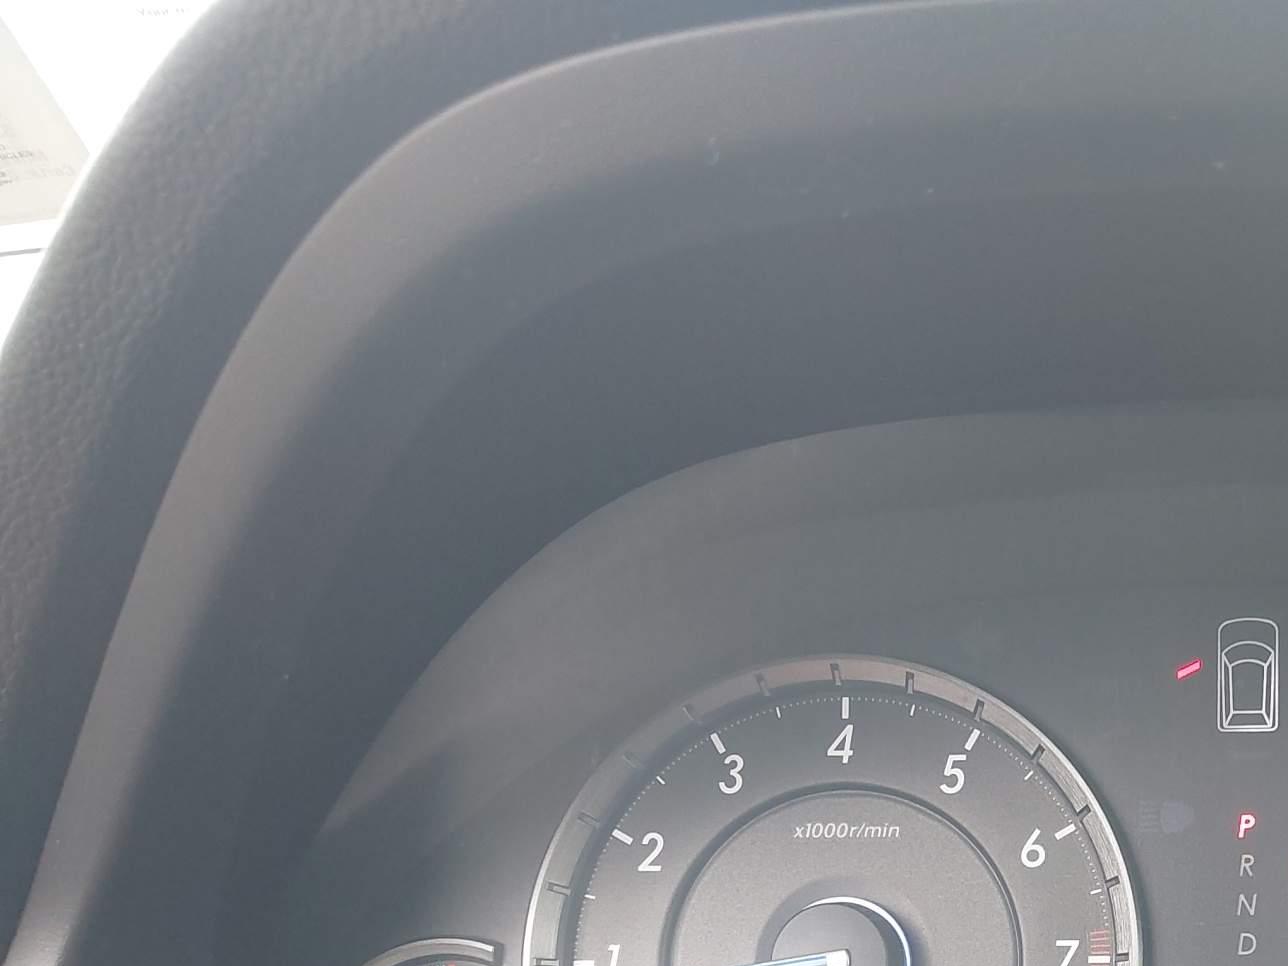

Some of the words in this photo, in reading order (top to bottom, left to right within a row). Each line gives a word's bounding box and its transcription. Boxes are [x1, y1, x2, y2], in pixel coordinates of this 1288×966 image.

[827, 725, 854, 763] 4
[719, 753, 744, 794] 3
[940, 755, 966, 795] 5
[793, 821, 900, 841] x1000r/min
[1237, 815, 1255, 838] P
[638, 832, 662, 871] 2
[1021, 829, 1046, 868] 6
[1239, 856, 1254, 877] R
[1236, 894, 1257, 916] N
[1238, 934, 1257, 956] D
